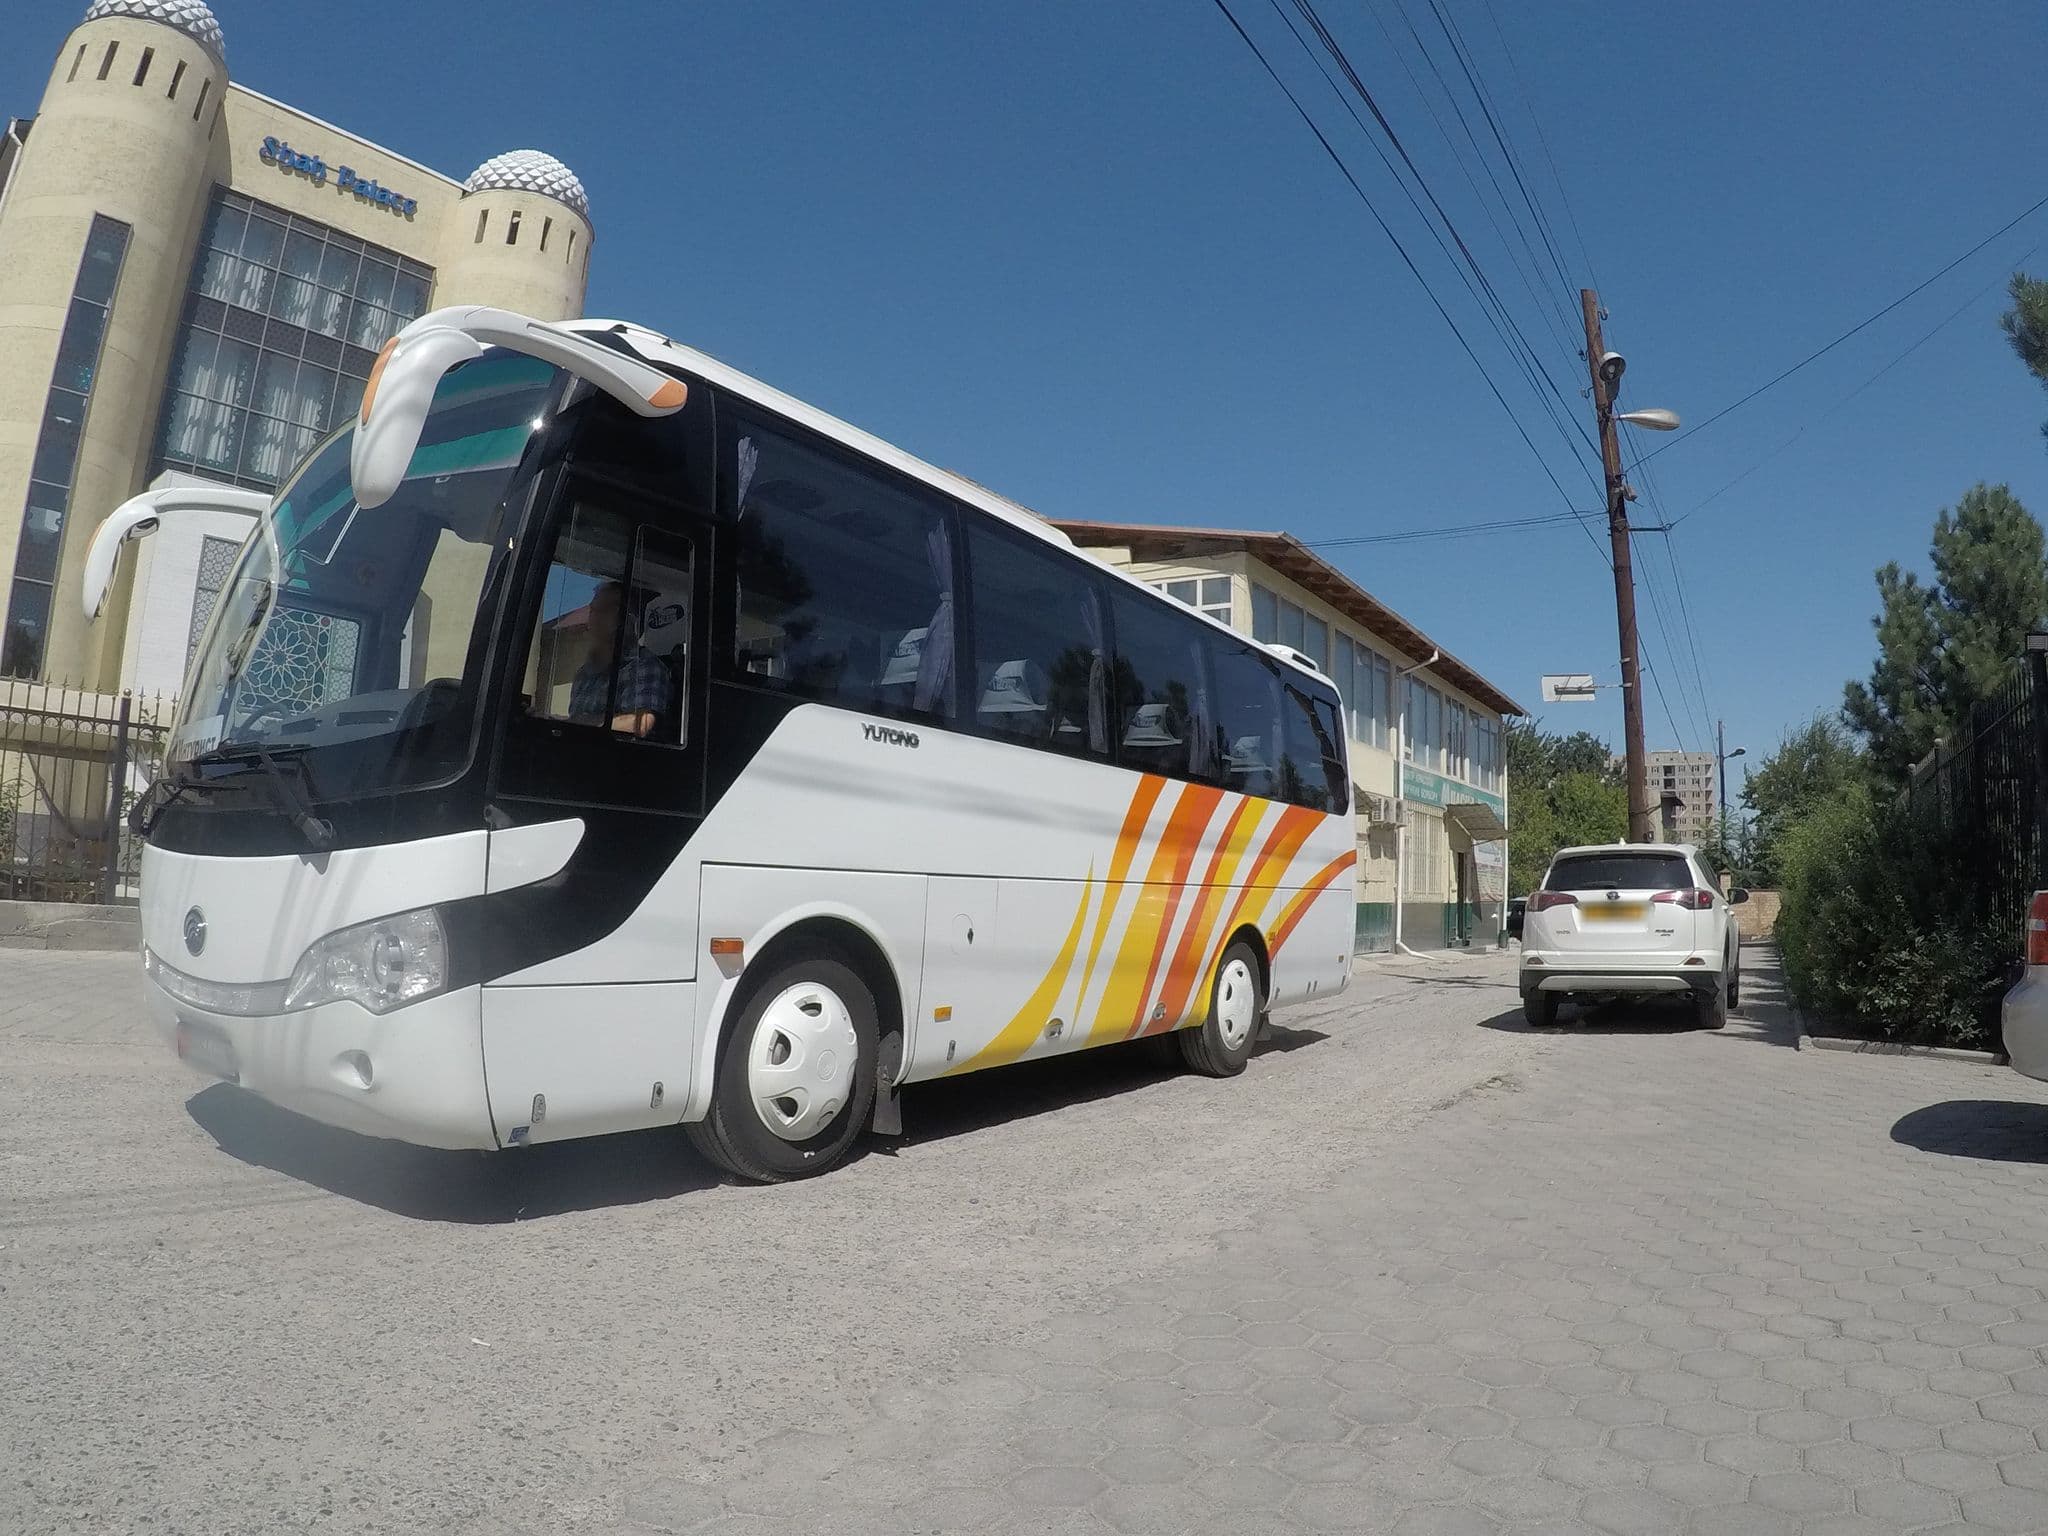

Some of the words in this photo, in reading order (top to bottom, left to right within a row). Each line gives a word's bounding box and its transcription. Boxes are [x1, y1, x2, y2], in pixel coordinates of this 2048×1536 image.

[259, 136, 327, 181] Shah
[337, 165, 418, 217] Palace
[861, 722, 920, 749] YUTONG
